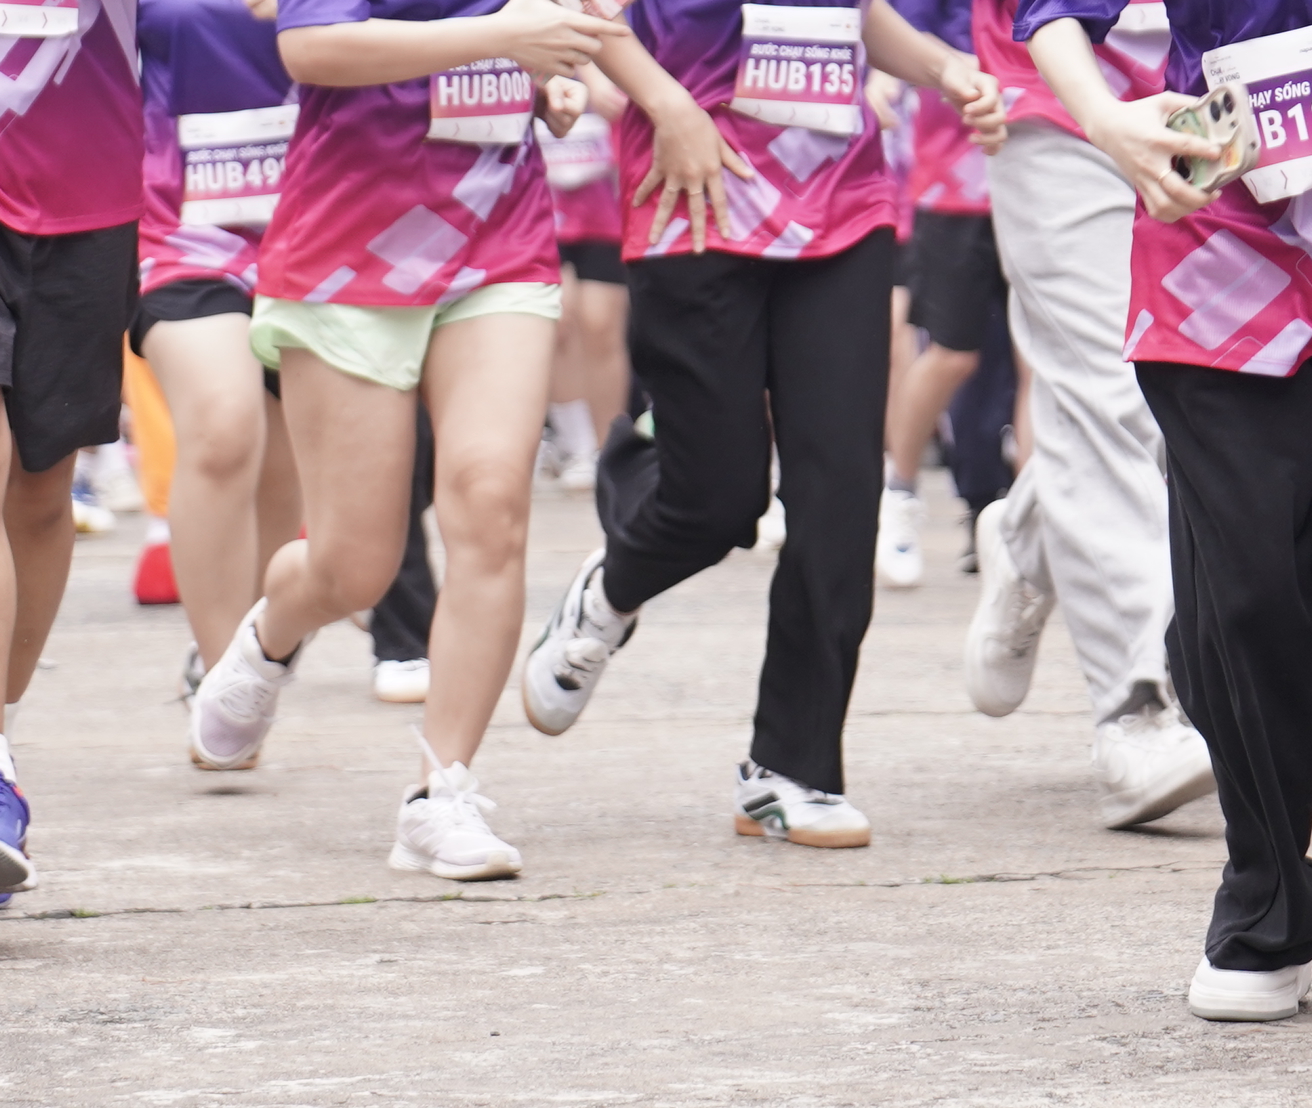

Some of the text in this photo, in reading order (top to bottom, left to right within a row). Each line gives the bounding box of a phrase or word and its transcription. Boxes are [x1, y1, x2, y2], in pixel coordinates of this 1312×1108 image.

[744, 58, 854, 94] HUB135
[1249, 90, 1272, 109] HẠY
[1274, 81, 1311, 102] SỐNG
